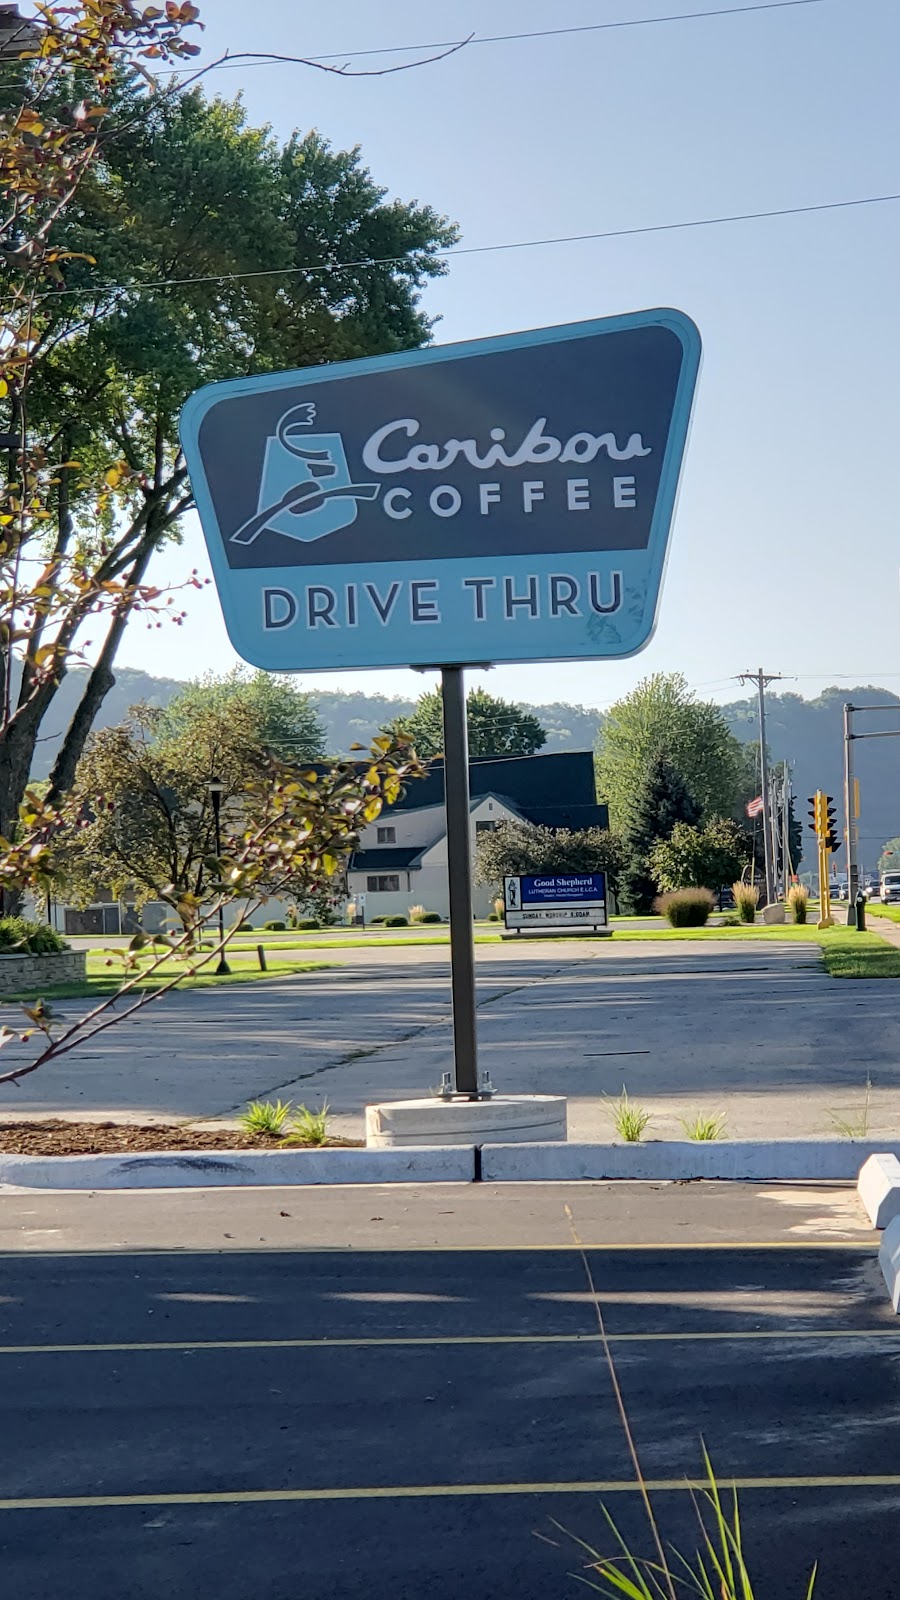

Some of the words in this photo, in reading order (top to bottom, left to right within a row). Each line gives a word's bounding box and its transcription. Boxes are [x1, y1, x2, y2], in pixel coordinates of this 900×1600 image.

[362, 417, 652, 474] Caribou
[383, 475, 637, 520] COFFEE
[261, 578, 441, 632] DRIVE
[462, 571, 624, 622] THRU
[533, 878, 555, 887] Good
[556, 877, 593, 887] Shepherd
